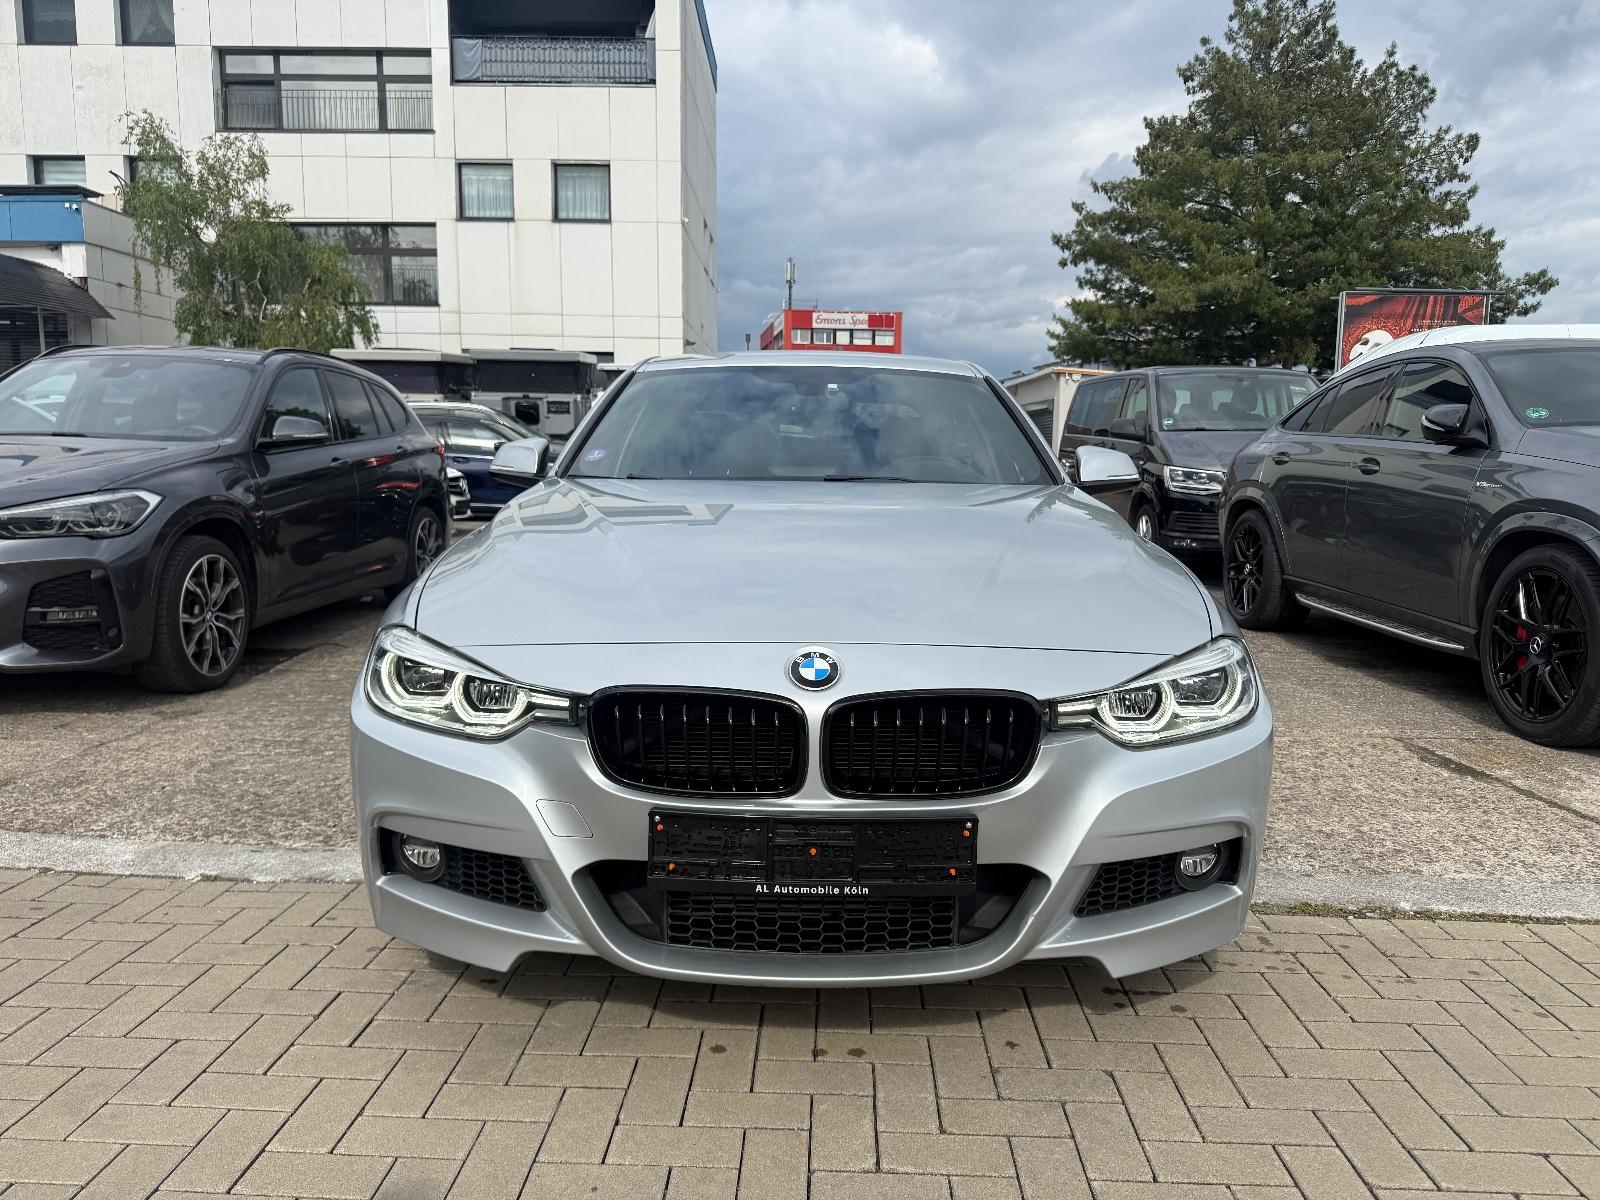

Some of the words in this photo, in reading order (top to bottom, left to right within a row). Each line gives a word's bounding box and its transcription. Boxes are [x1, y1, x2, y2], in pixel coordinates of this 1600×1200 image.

[815, 313, 846, 325] Emons
[795, 652, 836, 664] BMW
[755, 884, 770, 893] AL
[774, 884, 839, 895] Automobile
[844, 885, 869, 895] Köln
